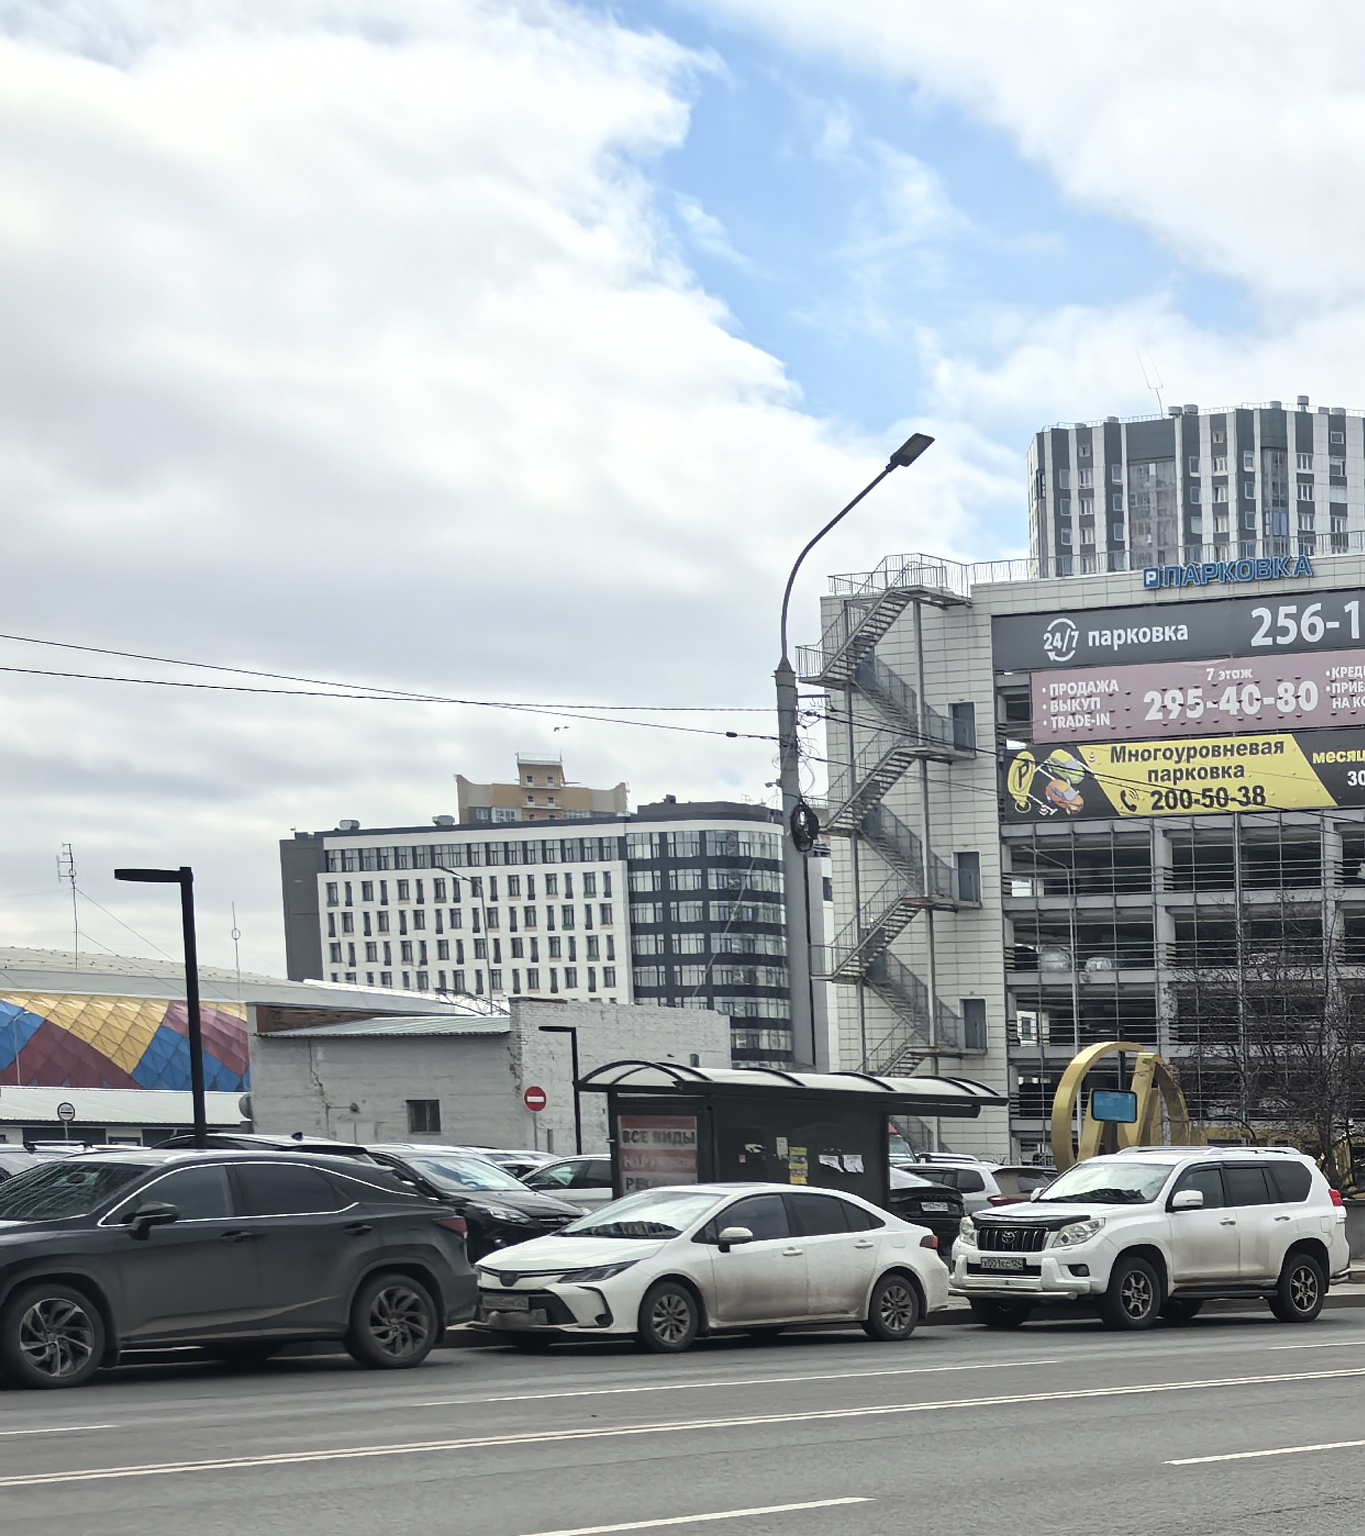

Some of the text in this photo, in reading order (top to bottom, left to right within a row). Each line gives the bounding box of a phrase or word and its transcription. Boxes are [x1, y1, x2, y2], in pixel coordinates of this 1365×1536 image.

[1163, 556, 1313, 587] ПАРКОВКА
[1043, 624, 1188, 652] 24/7 парковка
[1206, 668, 1253, 681] 7 этаж
[1050, 679, 1119, 696] ПРОДАЖА
[1050, 697, 1101, 712] ВЫКУП
[1143, 680, 1319, 721] 295-40-80
[1333, 696, 1351, 709] НА
[1051, 713, 1111, 728] TRADE-IN
[1110, 741, 1284, 764] Многоуровневая
[1147, 764, 1245, 786] парковка
[1151, 785, 1266, 812] 200-50-38
[622, 1130, 649, 1144] ВСЕ
